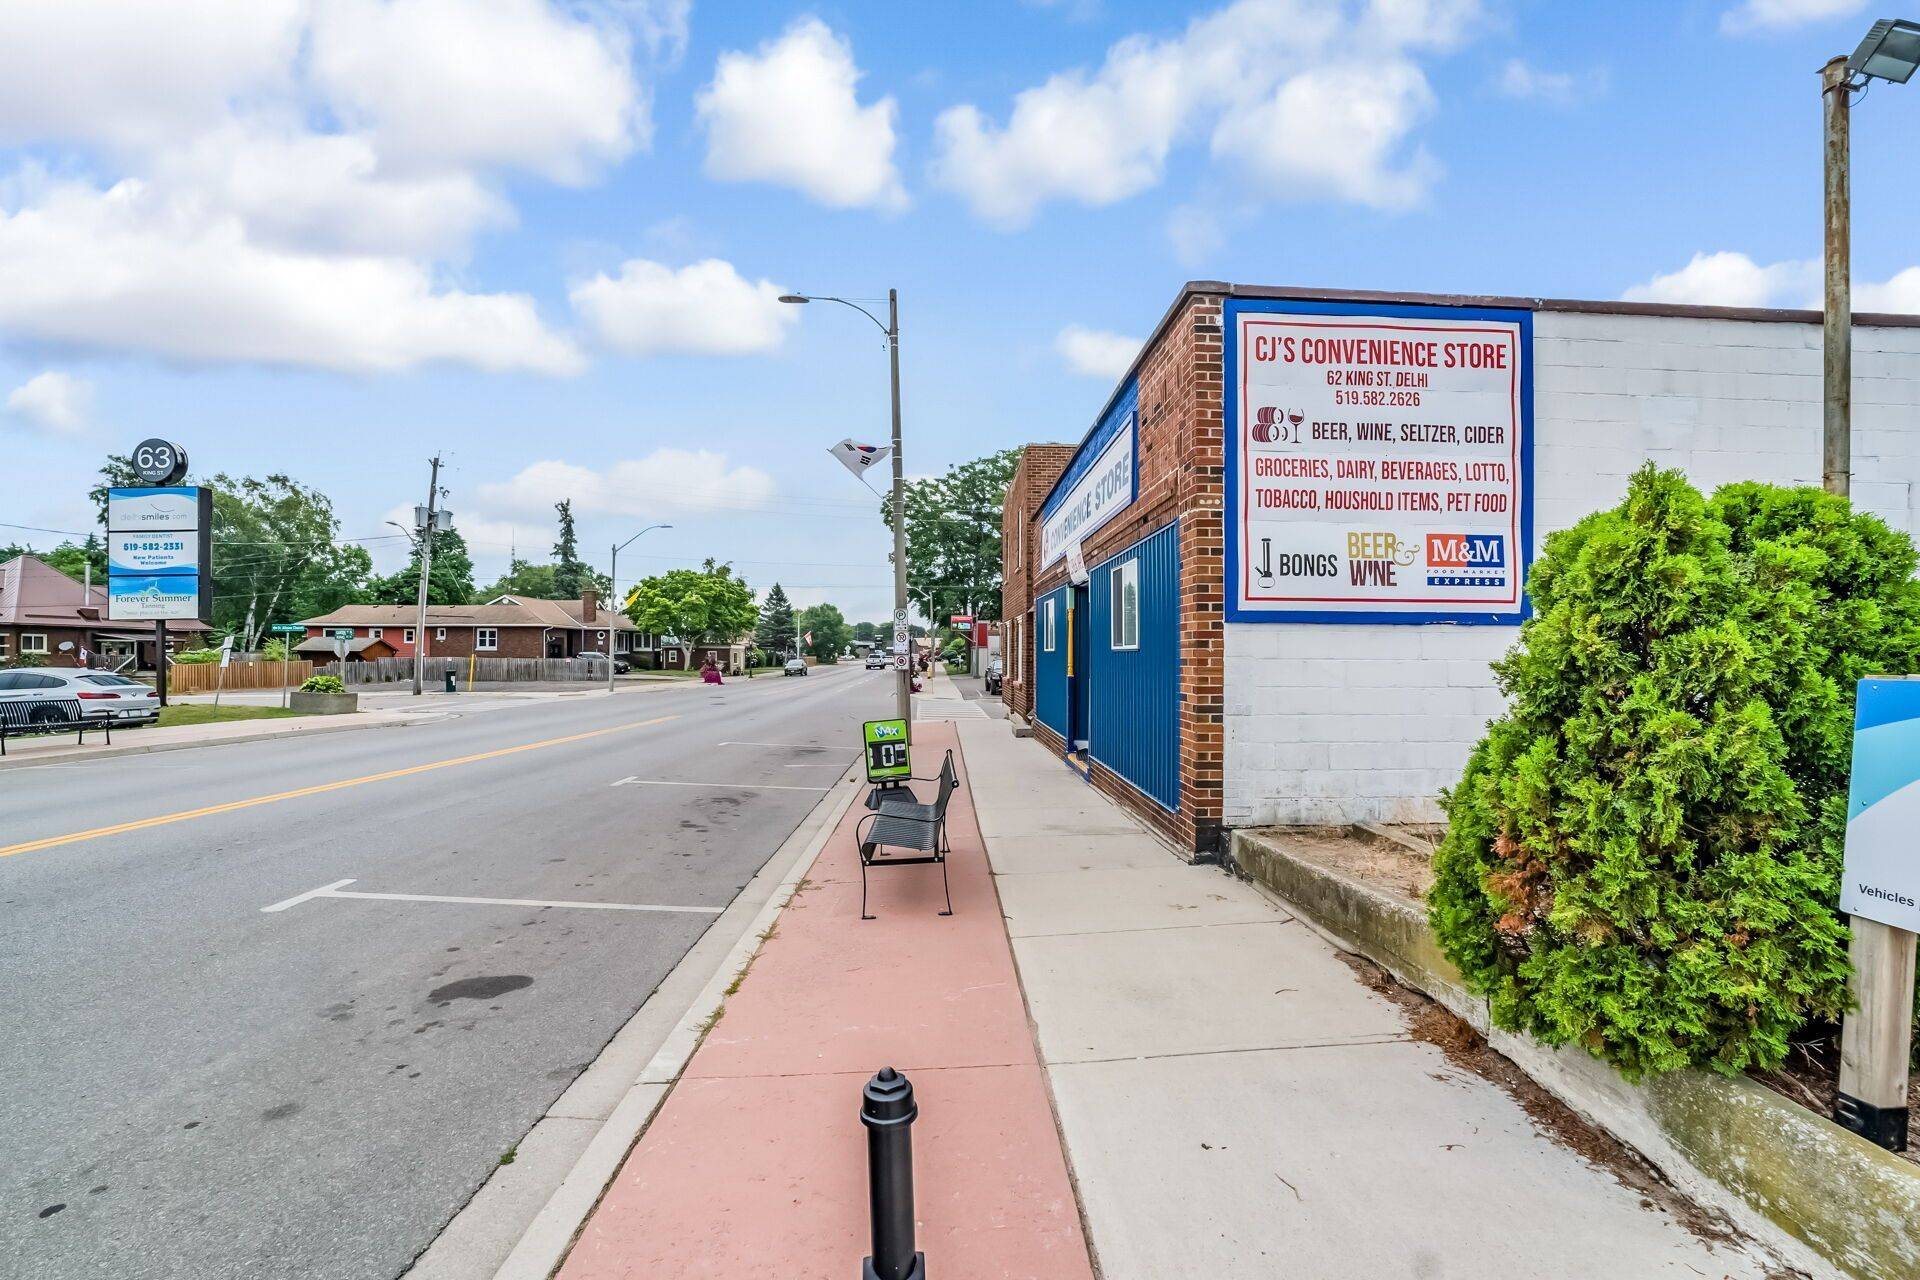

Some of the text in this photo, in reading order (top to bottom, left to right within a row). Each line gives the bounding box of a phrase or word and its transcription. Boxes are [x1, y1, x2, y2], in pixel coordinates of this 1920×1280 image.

[1256, 336, 1507, 369] CJ'S CONVENIENCE STORE
[1327, 371, 1428, 387] 62 KING ST. DELHI
[1336, 390, 1420, 406] 519.582.2626
[1313, 422, 1504, 445] BEER, WINE, SELTZER, CIDER
[138, 447, 170, 468] 63
[1255, 458, 1509, 484] GROCERIES, DAIRY, BEVERAGES, LOTTO,
[1052, 452, 1130, 550] CONVENIENCE STORE
[1255, 489, 1507, 514] TOBACCO, HOUSHOLD ITEMS, PET FOOD
[1347, 532, 1397, 558] BEER
[1432, 539, 1500, 562] M&M
[1280, 554, 1338, 577] BONGS
[152, 594, 192, 602] Summer
[1859, 884, 1915, 907] Vehicles
